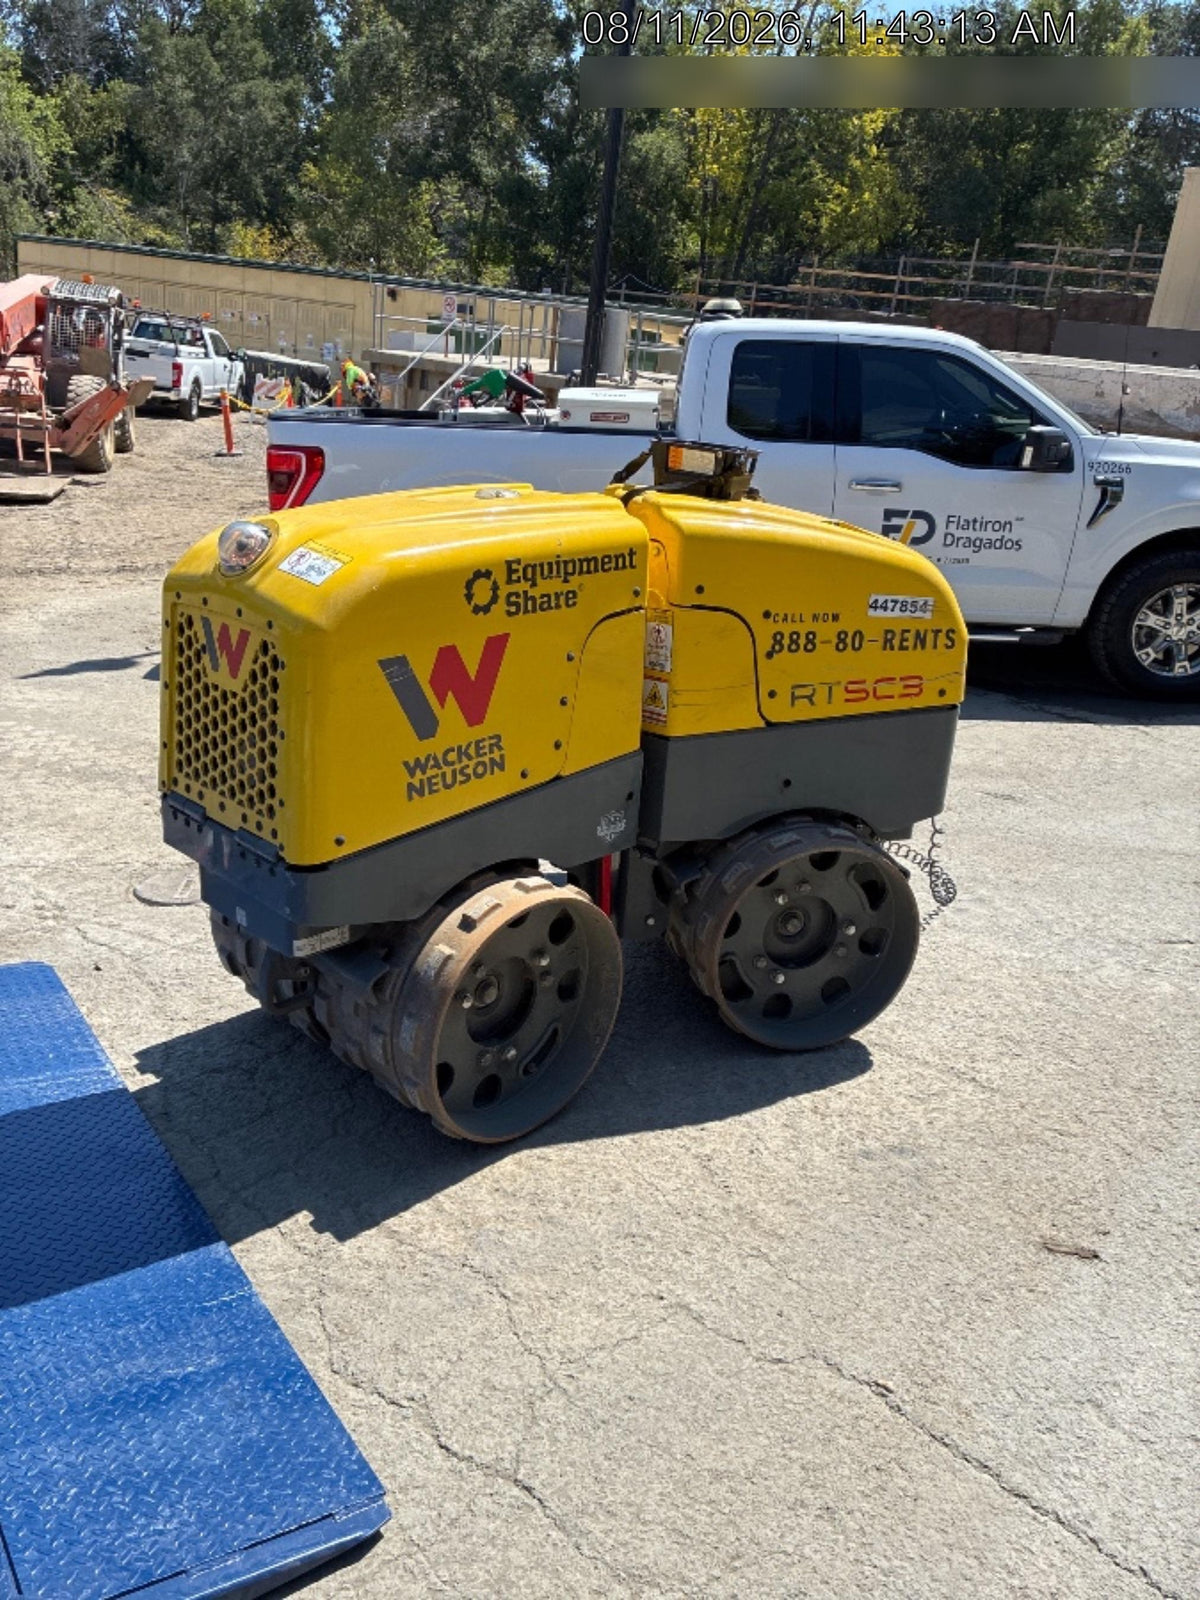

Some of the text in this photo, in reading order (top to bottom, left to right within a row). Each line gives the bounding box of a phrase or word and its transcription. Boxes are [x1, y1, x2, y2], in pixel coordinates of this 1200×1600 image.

[1088, 461, 1132, 475] 920266
[945, 514, 1013, 533] Flatiron
[943, 532, 1023, 553] Dragados
[505, 547, 637, 588] Equipment
[505, 589, 578, 617] Share
[869, 598, 930, 614] 447854
[773, 612, 841, 624] CALL NOW
[771, 628, 957, 654] 888-80-RENTS
[402, 734, 504, 779] WACKER
[406, 754, 505, 802] NEUSON
